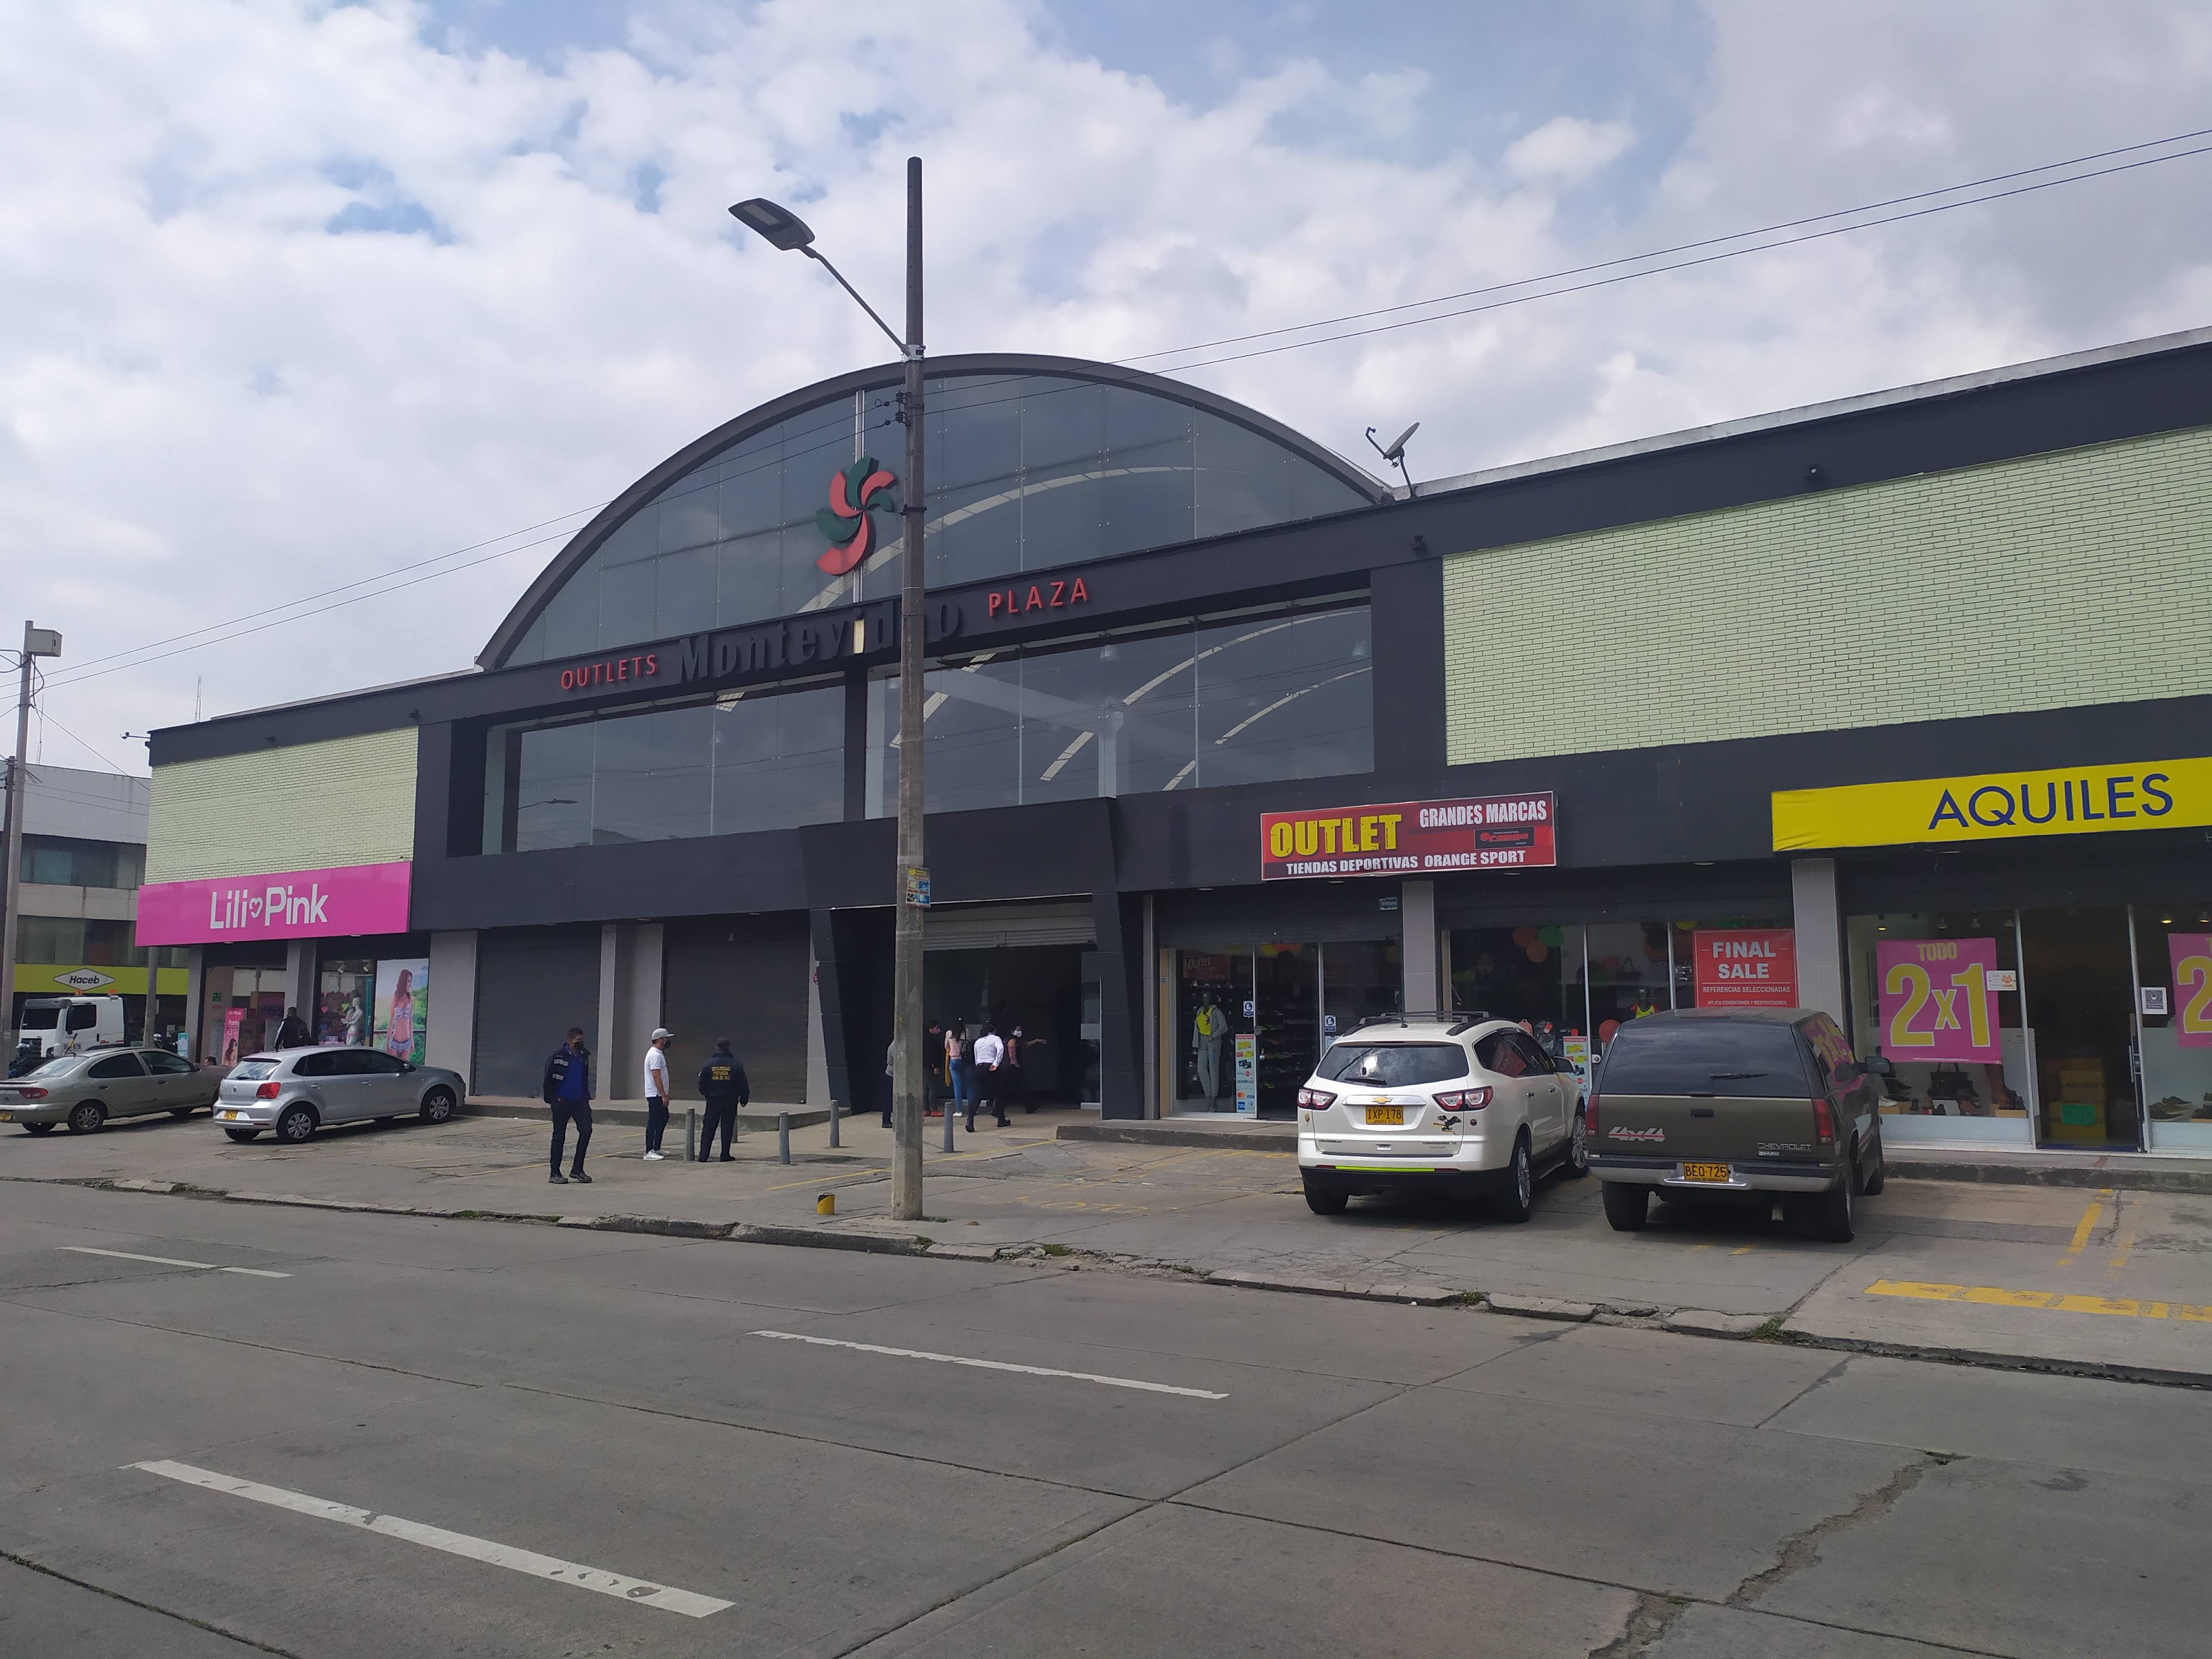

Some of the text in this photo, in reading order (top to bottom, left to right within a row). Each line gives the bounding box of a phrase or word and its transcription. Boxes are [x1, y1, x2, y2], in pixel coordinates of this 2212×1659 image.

[561, 578, 1088, 690] OUTLETS Montevido PLAZA
[1928, 773, 2173, 830] AQUILES
[1420, 800, 1547, 828] GRANDES MARCAS
[1270, 814, 1402, 858] OUTLET
[1286, 851, 1526, 875] TIENDAS DEPORTIVAS ORANGE SPORT
[210, 883, 329, 929] Lili Pink
[1713, 941, 1777, 958] FINAL
[1917, 942, 1958, 962] TODO
[1188, 957, 1212, 969] Outlet
[1718, 963, 1770, 979] SALE
[69, 975, 100, 984] Haceb
[1368, 1109, 1402, 1120] IXP 178
[1608, 1126, 1665, 1142] 4x4
[1757, 1142, 1812, 1151] CHEVROLET
[1707, 1166, 1726, 1178] 725
